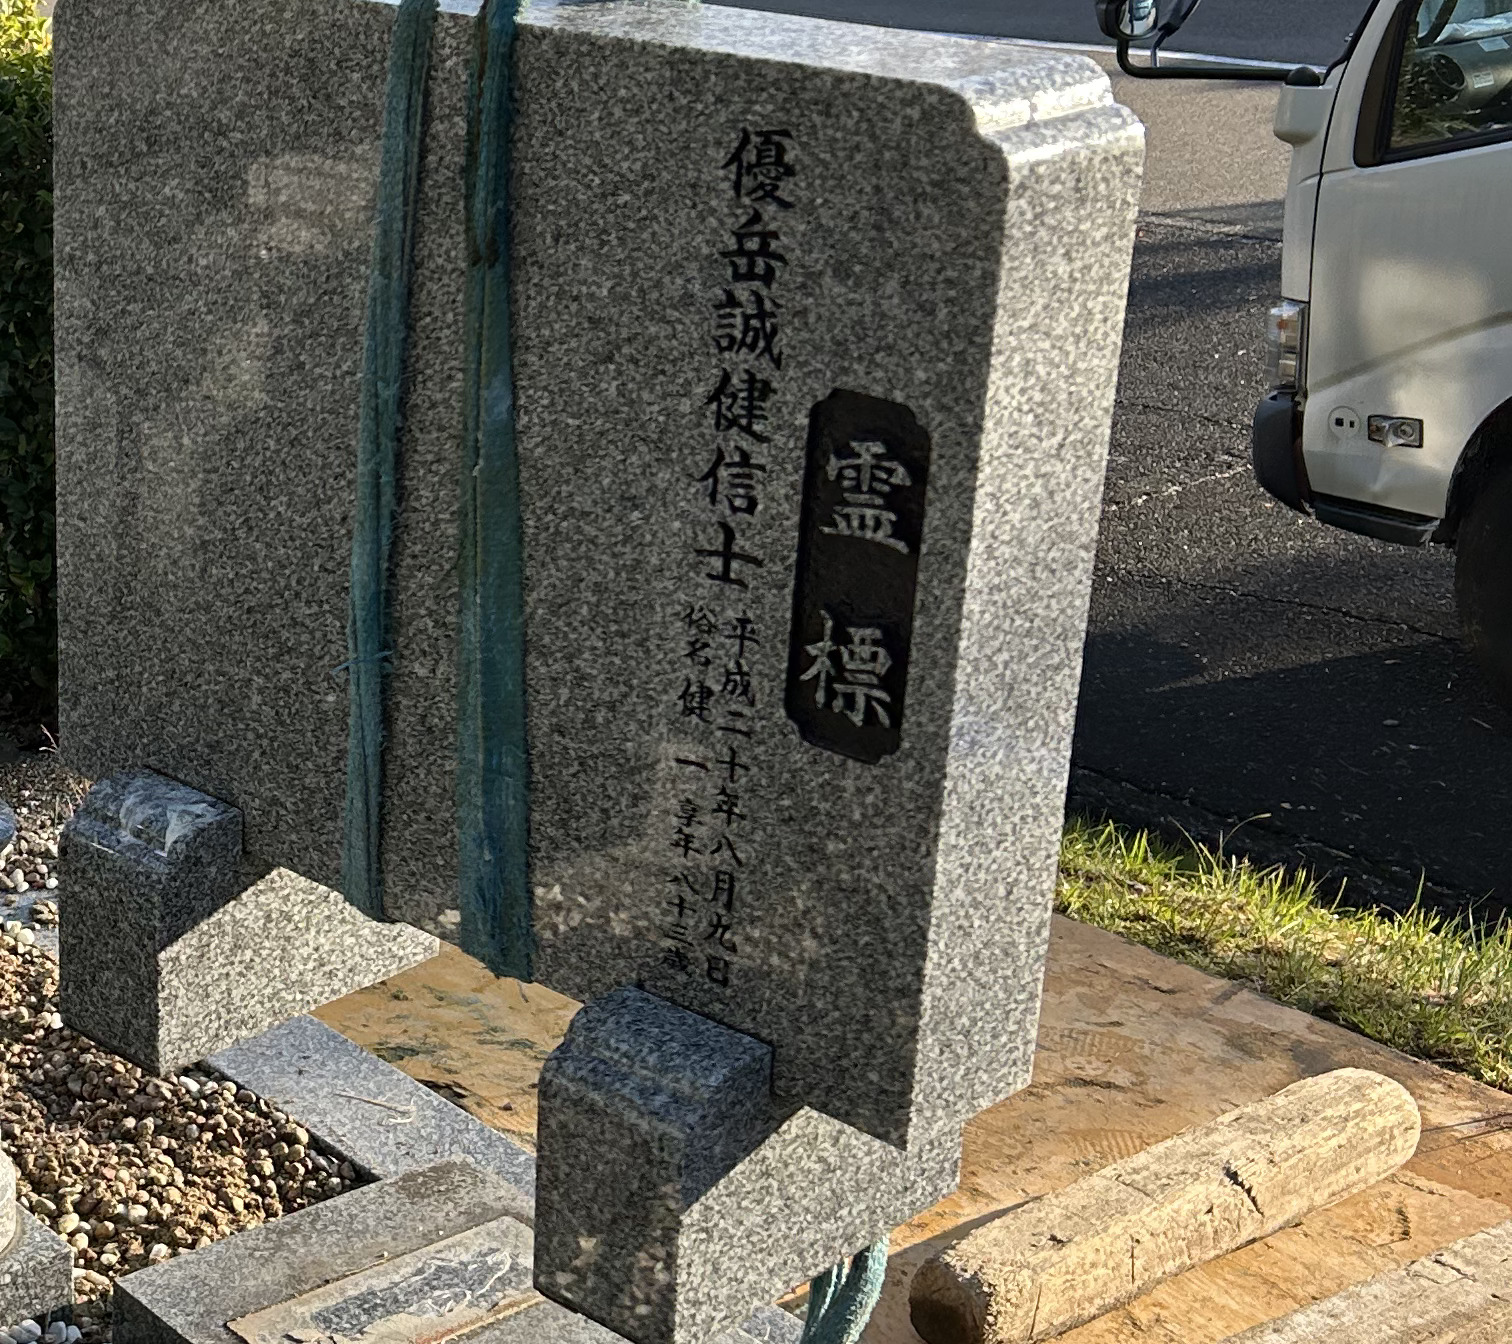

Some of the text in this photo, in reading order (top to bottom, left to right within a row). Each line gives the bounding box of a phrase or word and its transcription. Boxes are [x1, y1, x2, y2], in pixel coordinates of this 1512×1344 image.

[694, 126, 795, 588] 優岳誠健信士
[799, 439, 911, 729] 霊標
[704, 610, 761, 988] 平成二十年八月九日
